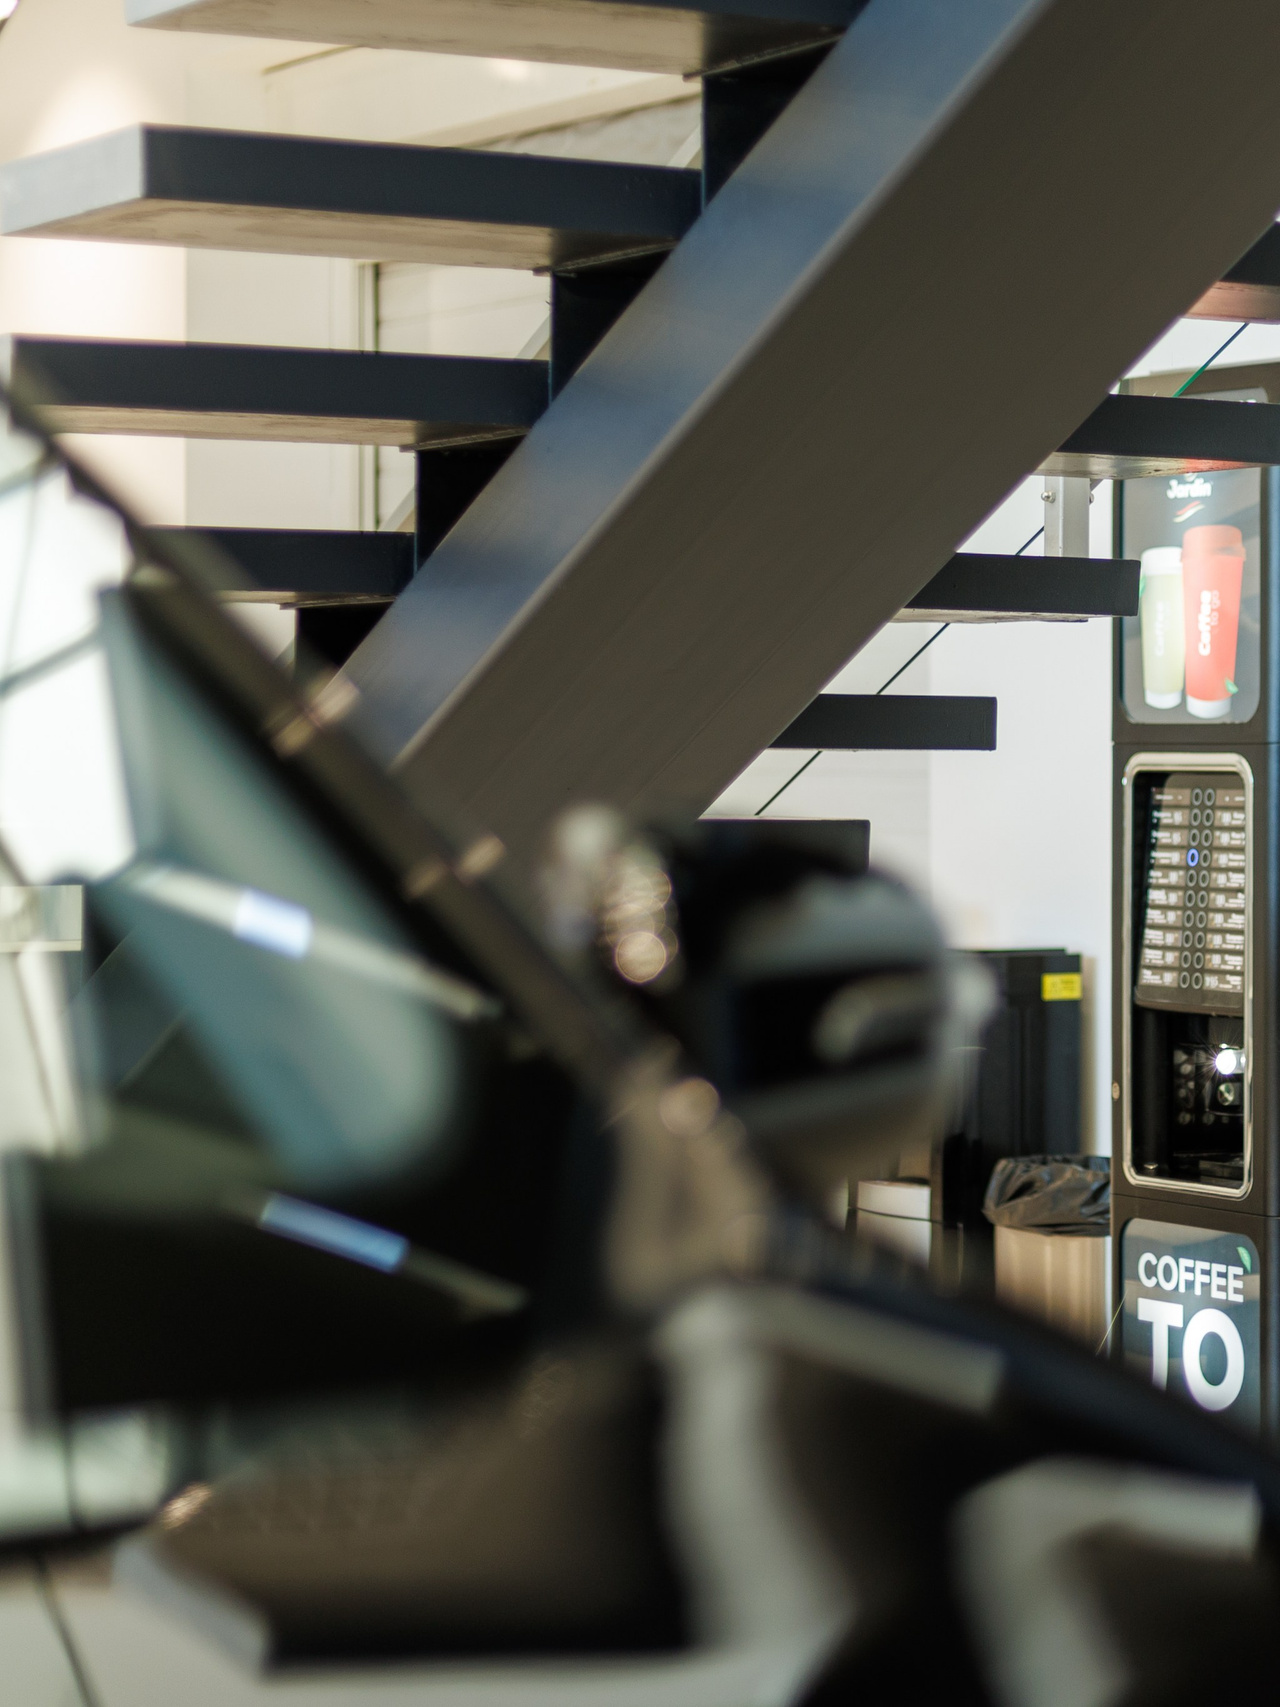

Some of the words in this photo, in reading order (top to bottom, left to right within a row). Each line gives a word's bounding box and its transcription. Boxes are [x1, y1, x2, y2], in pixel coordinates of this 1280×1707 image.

[1167, 478, 1212, 499] Jardin
[1198, 590, 1211, 656] Coffee
[1138, 1252, 1244, 1303] COFFEE
[1137, 1297, 1245, 1412] TO
